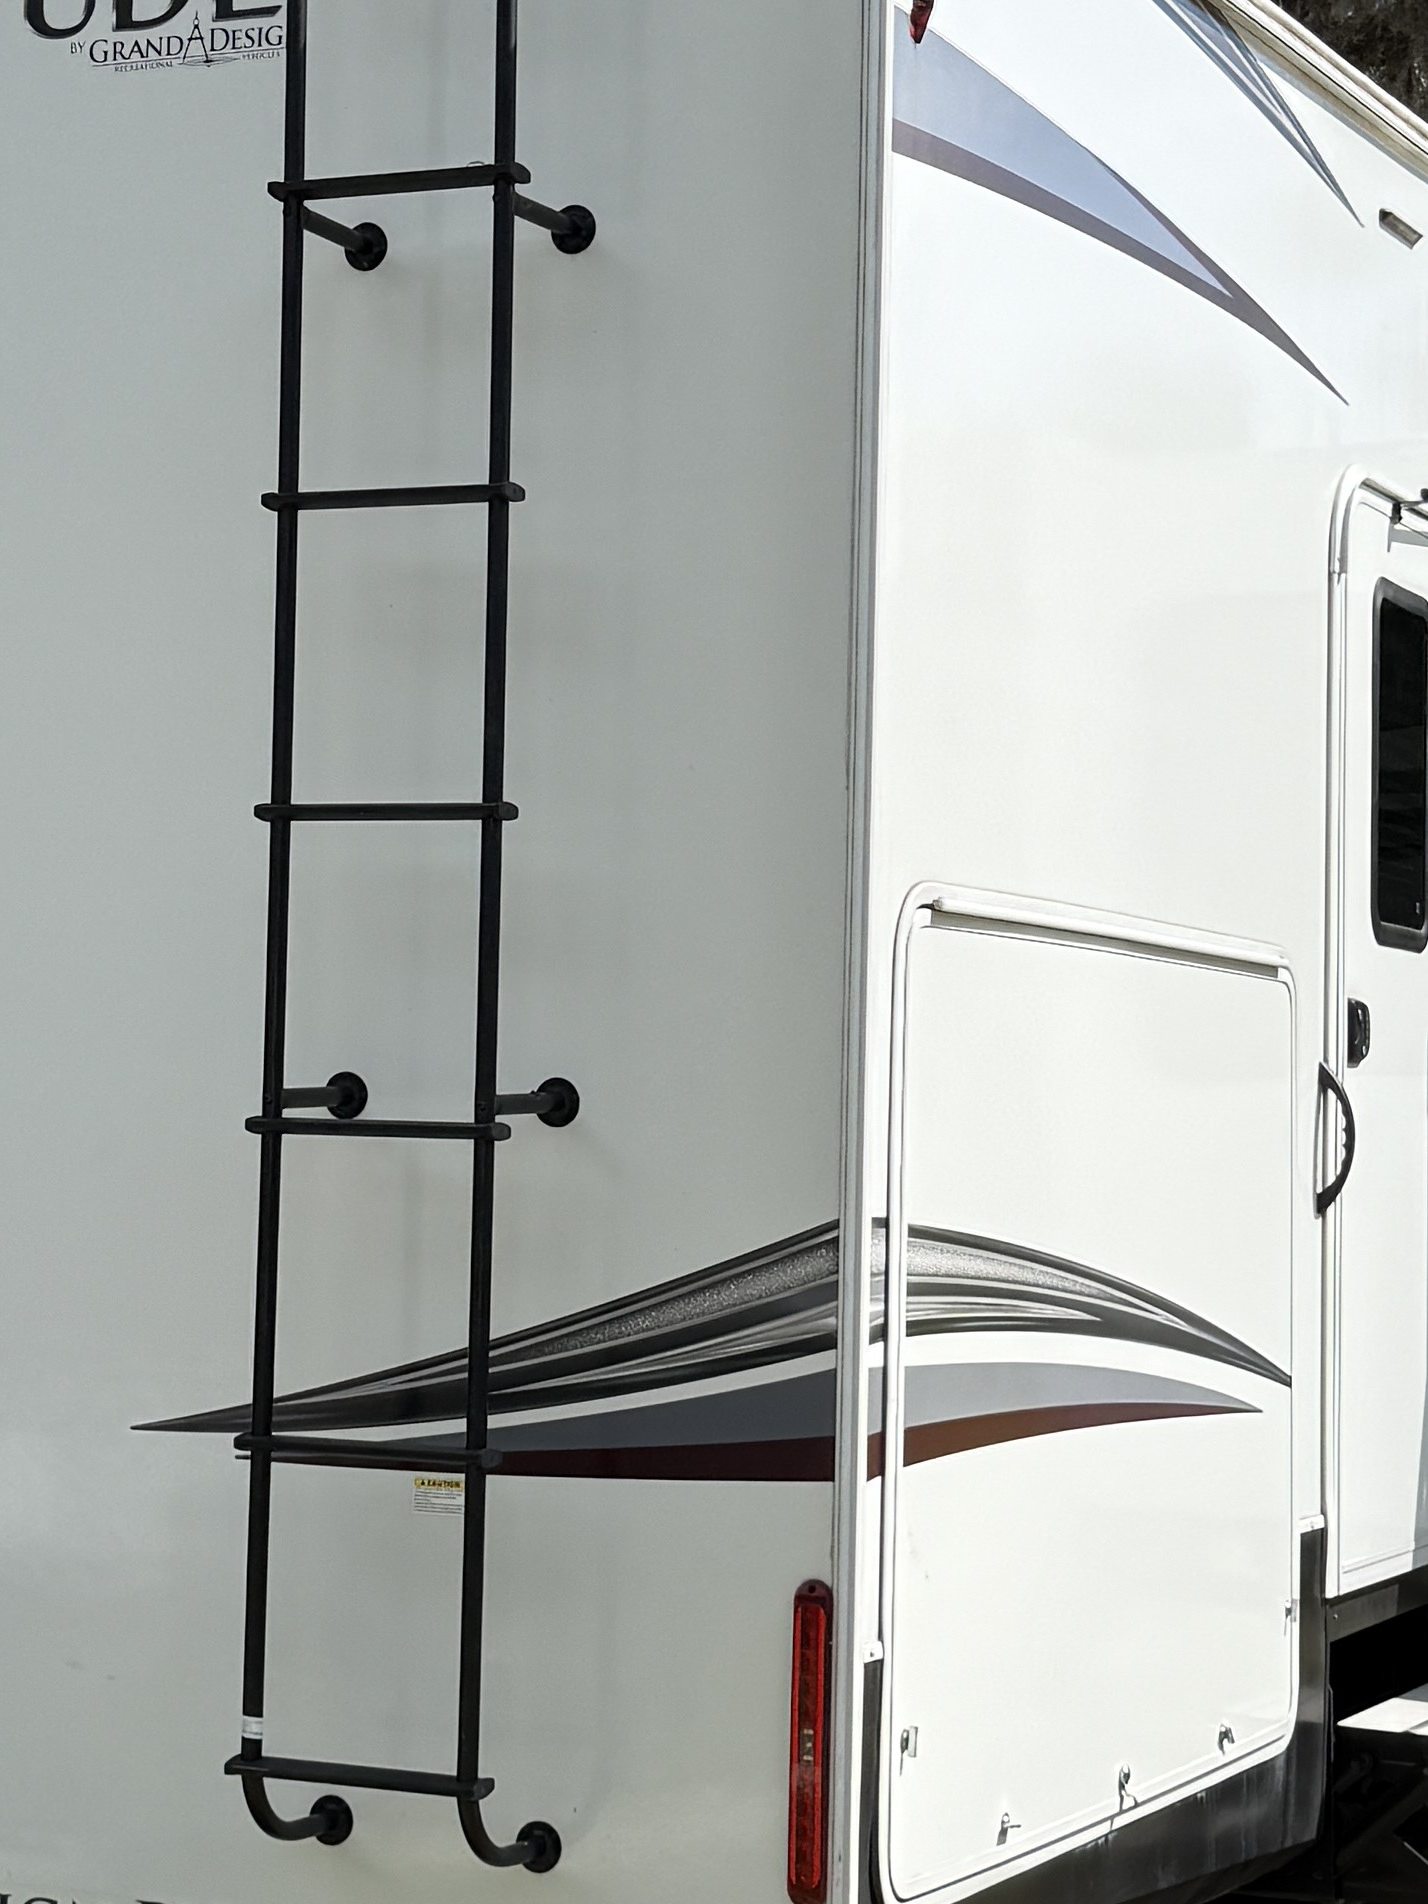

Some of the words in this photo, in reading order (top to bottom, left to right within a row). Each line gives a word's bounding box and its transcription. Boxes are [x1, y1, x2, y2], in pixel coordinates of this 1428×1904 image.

[70, 40, 86, 54] BY
[89, 35, 184, 63] GRAND
[210, 25, 284, 52] DESIG
